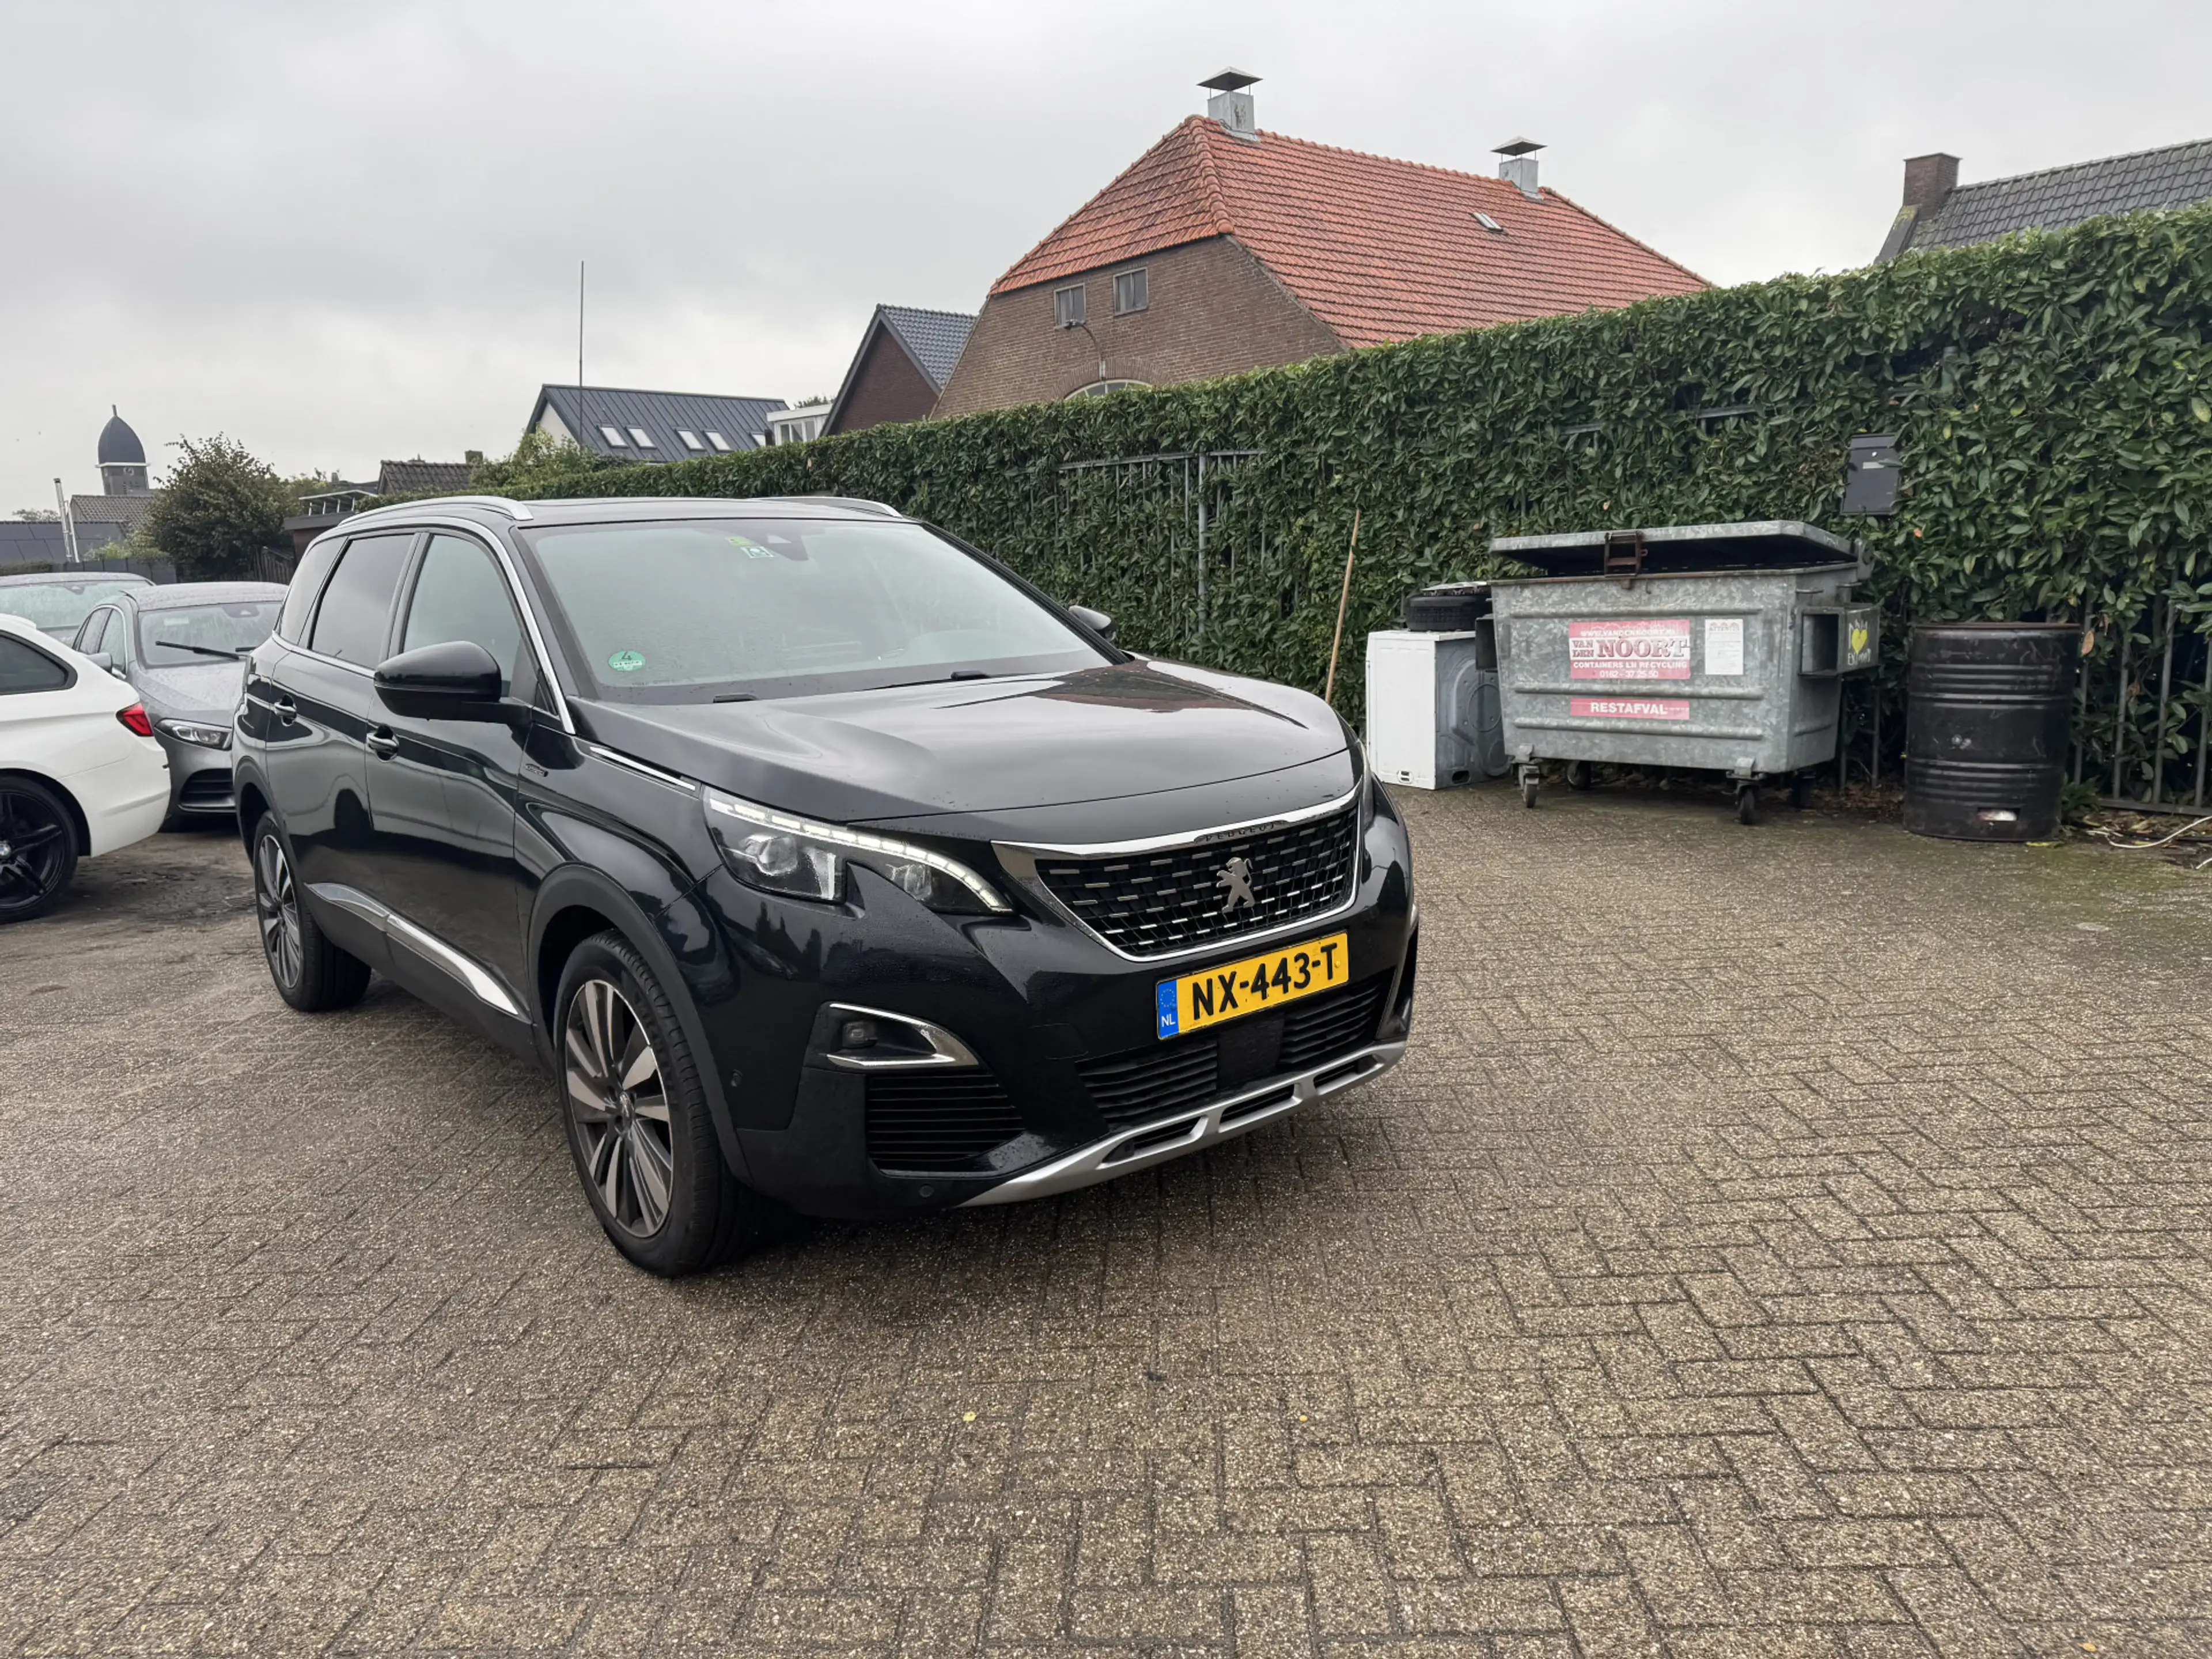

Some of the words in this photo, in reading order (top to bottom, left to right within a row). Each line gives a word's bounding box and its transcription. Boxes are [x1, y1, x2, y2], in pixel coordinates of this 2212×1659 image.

[1573, 640, 1593, 648] VAN
[1597, 638, 1688, 658] NOORT
[1573, 649, 1594, 658] DEN
[1590, 702, 1668, 715] RESTAFVAL
[1192, 942, 1338, 1020] NX-443-T
[1161, 1014, 1176, 1028] NL
